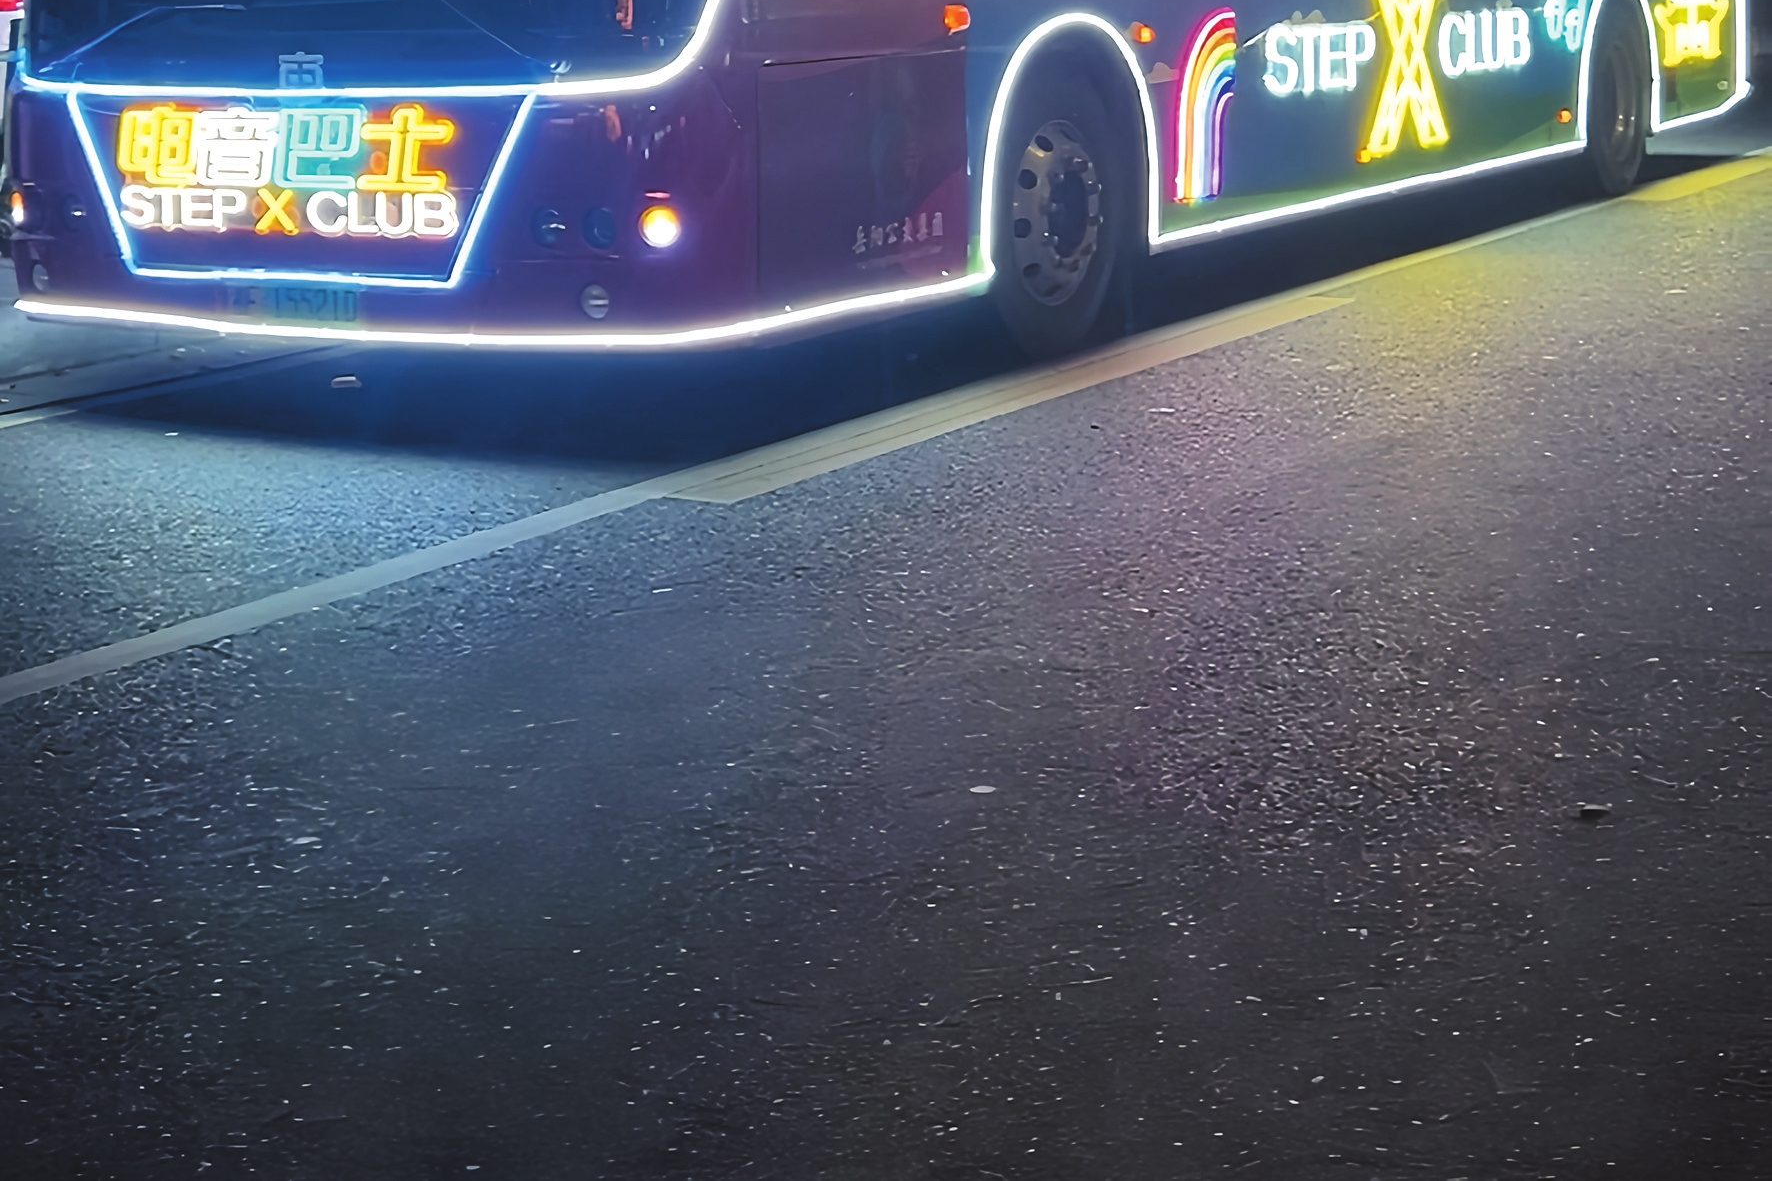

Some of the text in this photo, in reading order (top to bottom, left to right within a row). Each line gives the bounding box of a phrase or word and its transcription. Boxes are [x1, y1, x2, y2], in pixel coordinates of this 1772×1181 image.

[1263, 23, 1376, 94] STEP
[1438, 7, 1531, 78] CLUB
[118, 103, 455, 191] 电音巴士
[119, 186, 458, 237] STEP X CLUB
